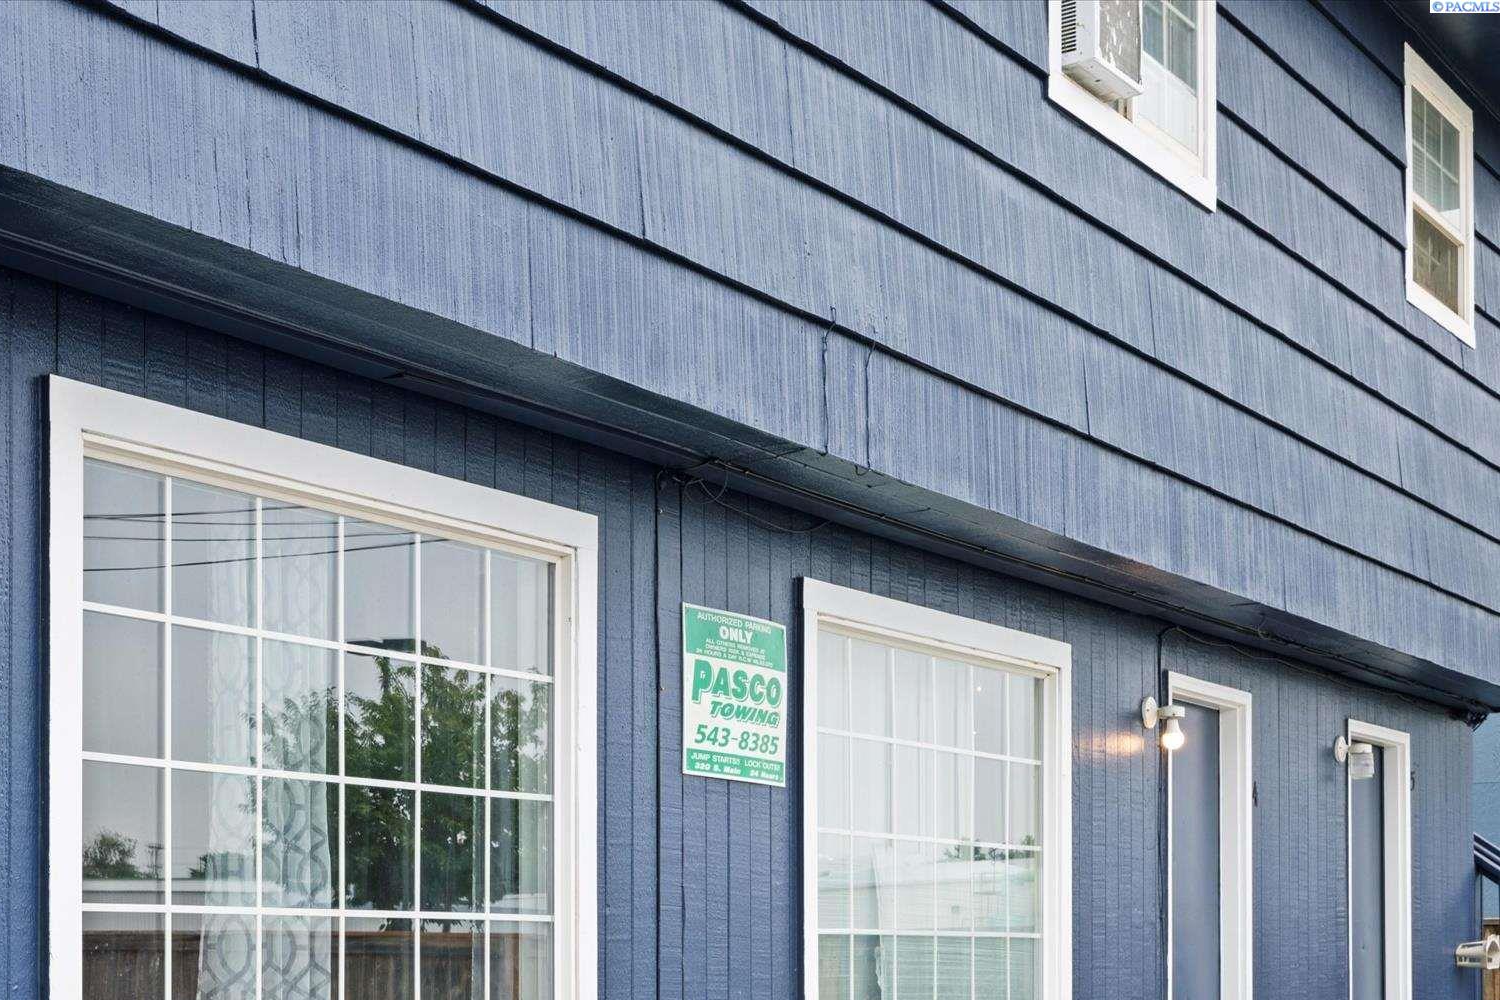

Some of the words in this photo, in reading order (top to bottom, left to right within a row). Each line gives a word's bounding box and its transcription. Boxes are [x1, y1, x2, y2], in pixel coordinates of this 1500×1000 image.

[697, 611, 743, 628] AUTHORIZED
[719, 625, 753, 644] ONLY
[691, 658, 782, 708] PASCO
[709, 700, 780, 728] TOWING
[694, 724, 780, 755] 543-8385
[691, 752, 711, 761] JUMP
[744, 760, 761, 769] LOCK
